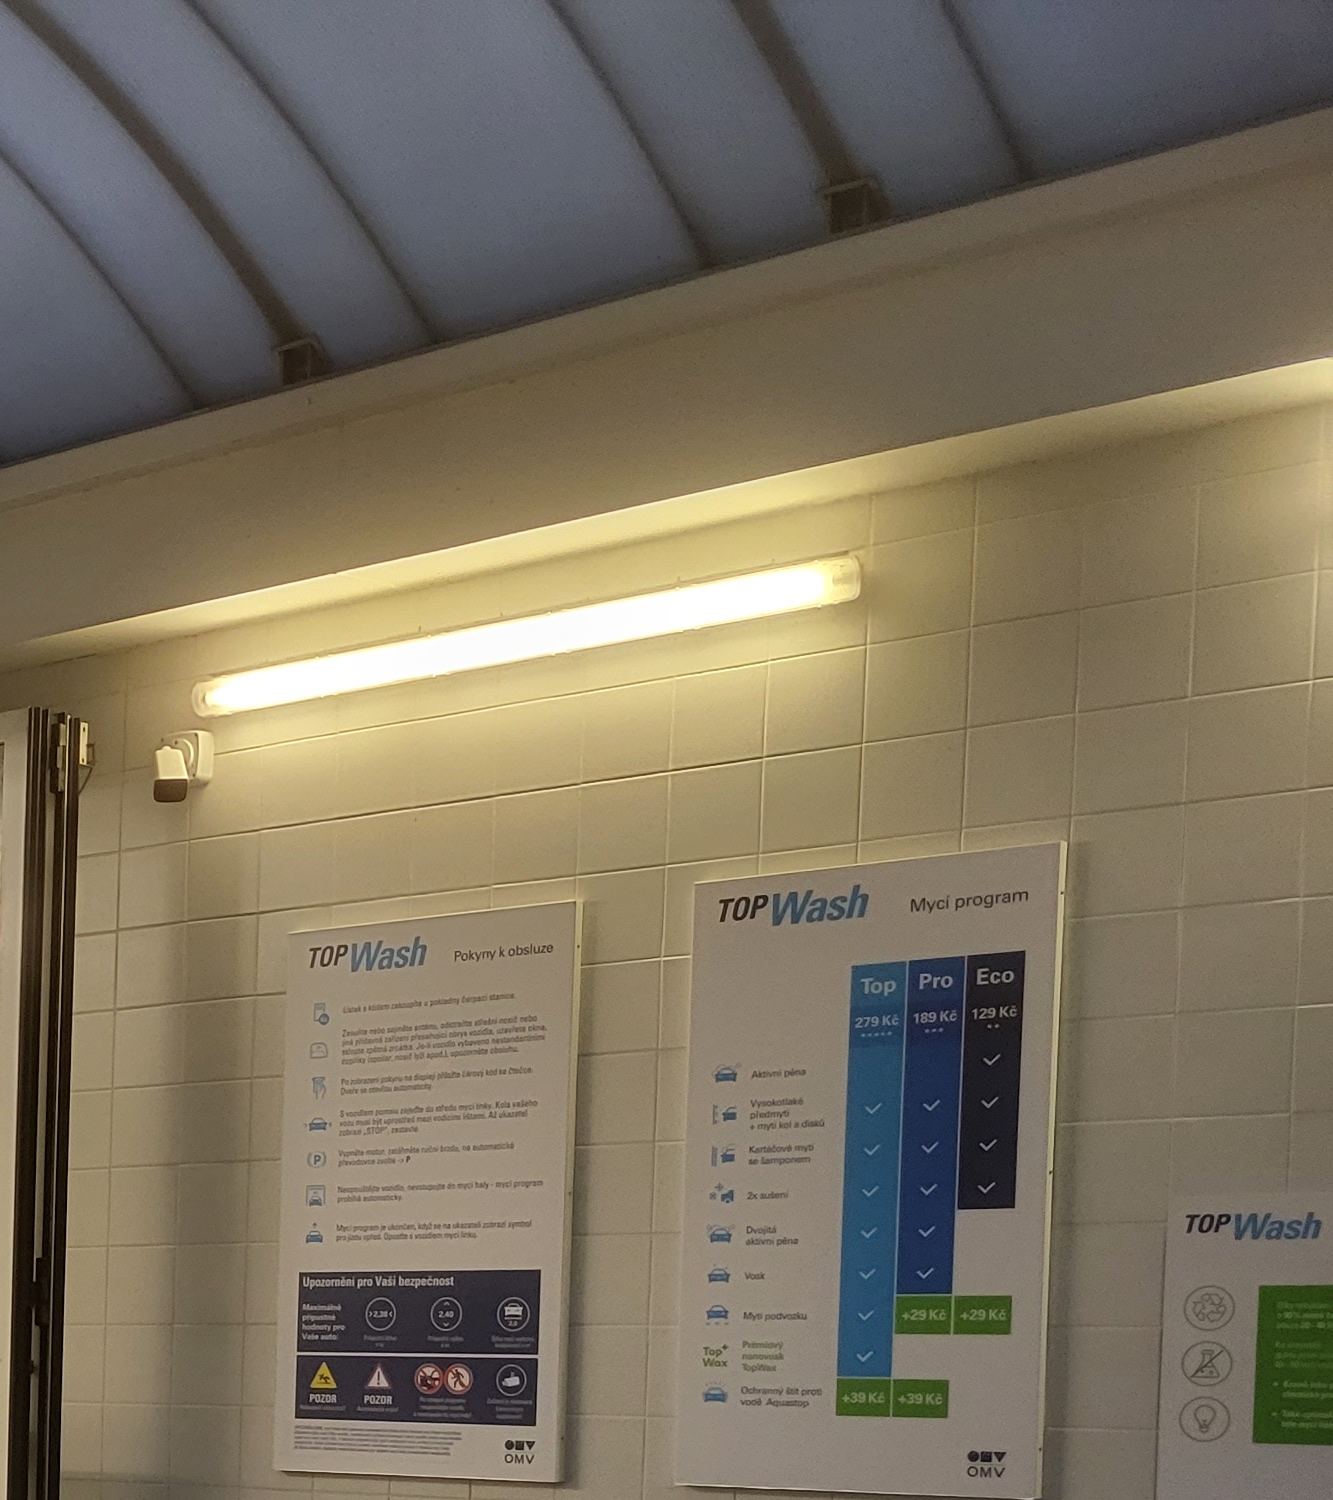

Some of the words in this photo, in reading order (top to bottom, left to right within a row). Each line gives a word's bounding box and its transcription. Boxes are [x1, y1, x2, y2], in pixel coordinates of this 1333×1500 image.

[910, 895, 950, 914] Mycí
[955, 890, 1029, 912] program
[454, 949, 497, 962] Pokyny
[498, 946, 506, 958] k
[508, 943, 554, 957] obsluze
[919, 973, 953, 990] Pro
[976, 967, 1014, 986] Eco
[860, 978, 896, 997] Top
[913, 1012, 937, 1025] 189
[940, 1010, 958, 1023] Kč
[972, 1007, 996, 1020] 129
[999, 1005, 1018, 1019] Kč
[855, 1016, 879, 1029] 279
[882, 1014, 899, 1027] Kč
[357, 1278, 373, 1289] pro
[375, 1275, 396, 1287] Vaši
[398, 1275, 454, 1289] bezpečnost
[901, 1309, 926, 1321] +29
[929, 1309, 946, 1321] Kč
[959, 1309, 984, 1321] +29
[988, 1309, 1006, 1321] Kč
[703, 1358, 728, 1367] Wax
[309, 1393, 337, 1403] POZOR
[364, 1395, 393, 1404] POZOR
[842, 1392, 865, 1404] +39
[897, 1393, 923, 1404] +39
[504, 1454, 535, 1464] OMV
[967, 1465, 1005, 1478] OMV
